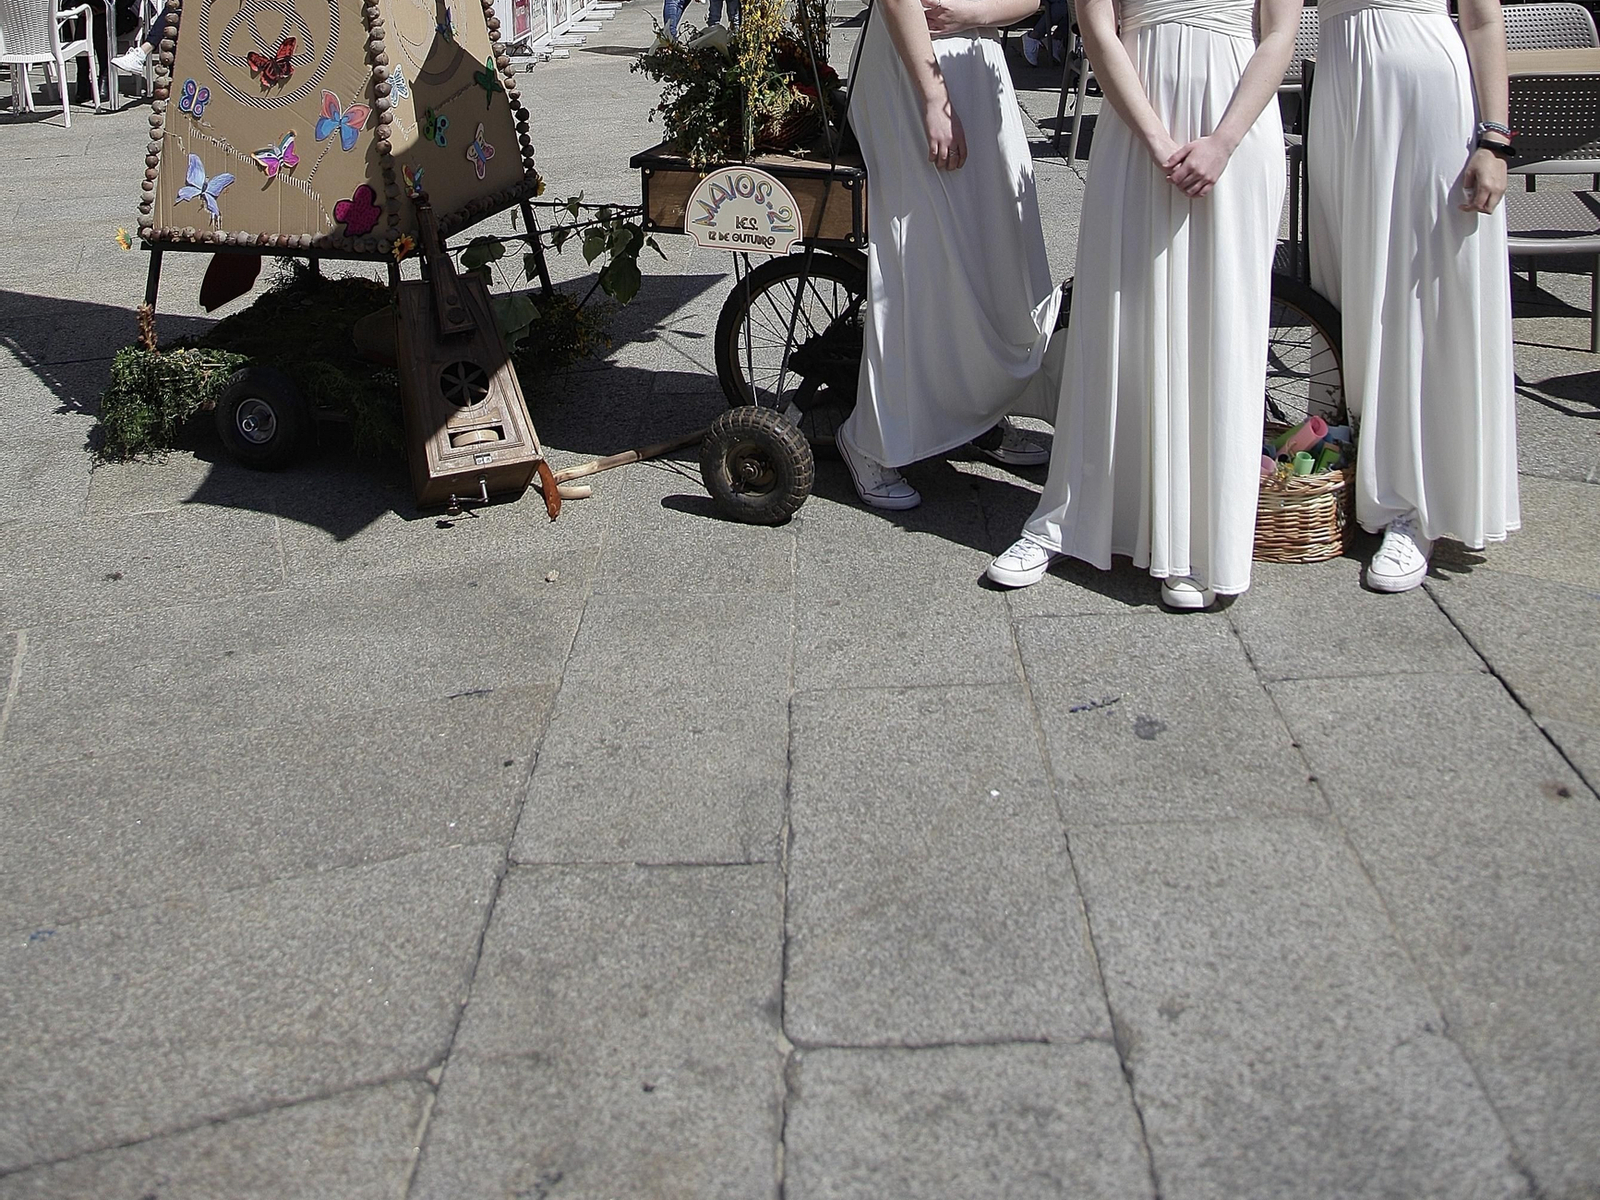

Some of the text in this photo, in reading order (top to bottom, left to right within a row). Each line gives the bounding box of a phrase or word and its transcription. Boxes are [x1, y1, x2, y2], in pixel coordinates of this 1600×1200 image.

[708, 231, 776, 249] 12 DE OUTUBRO
